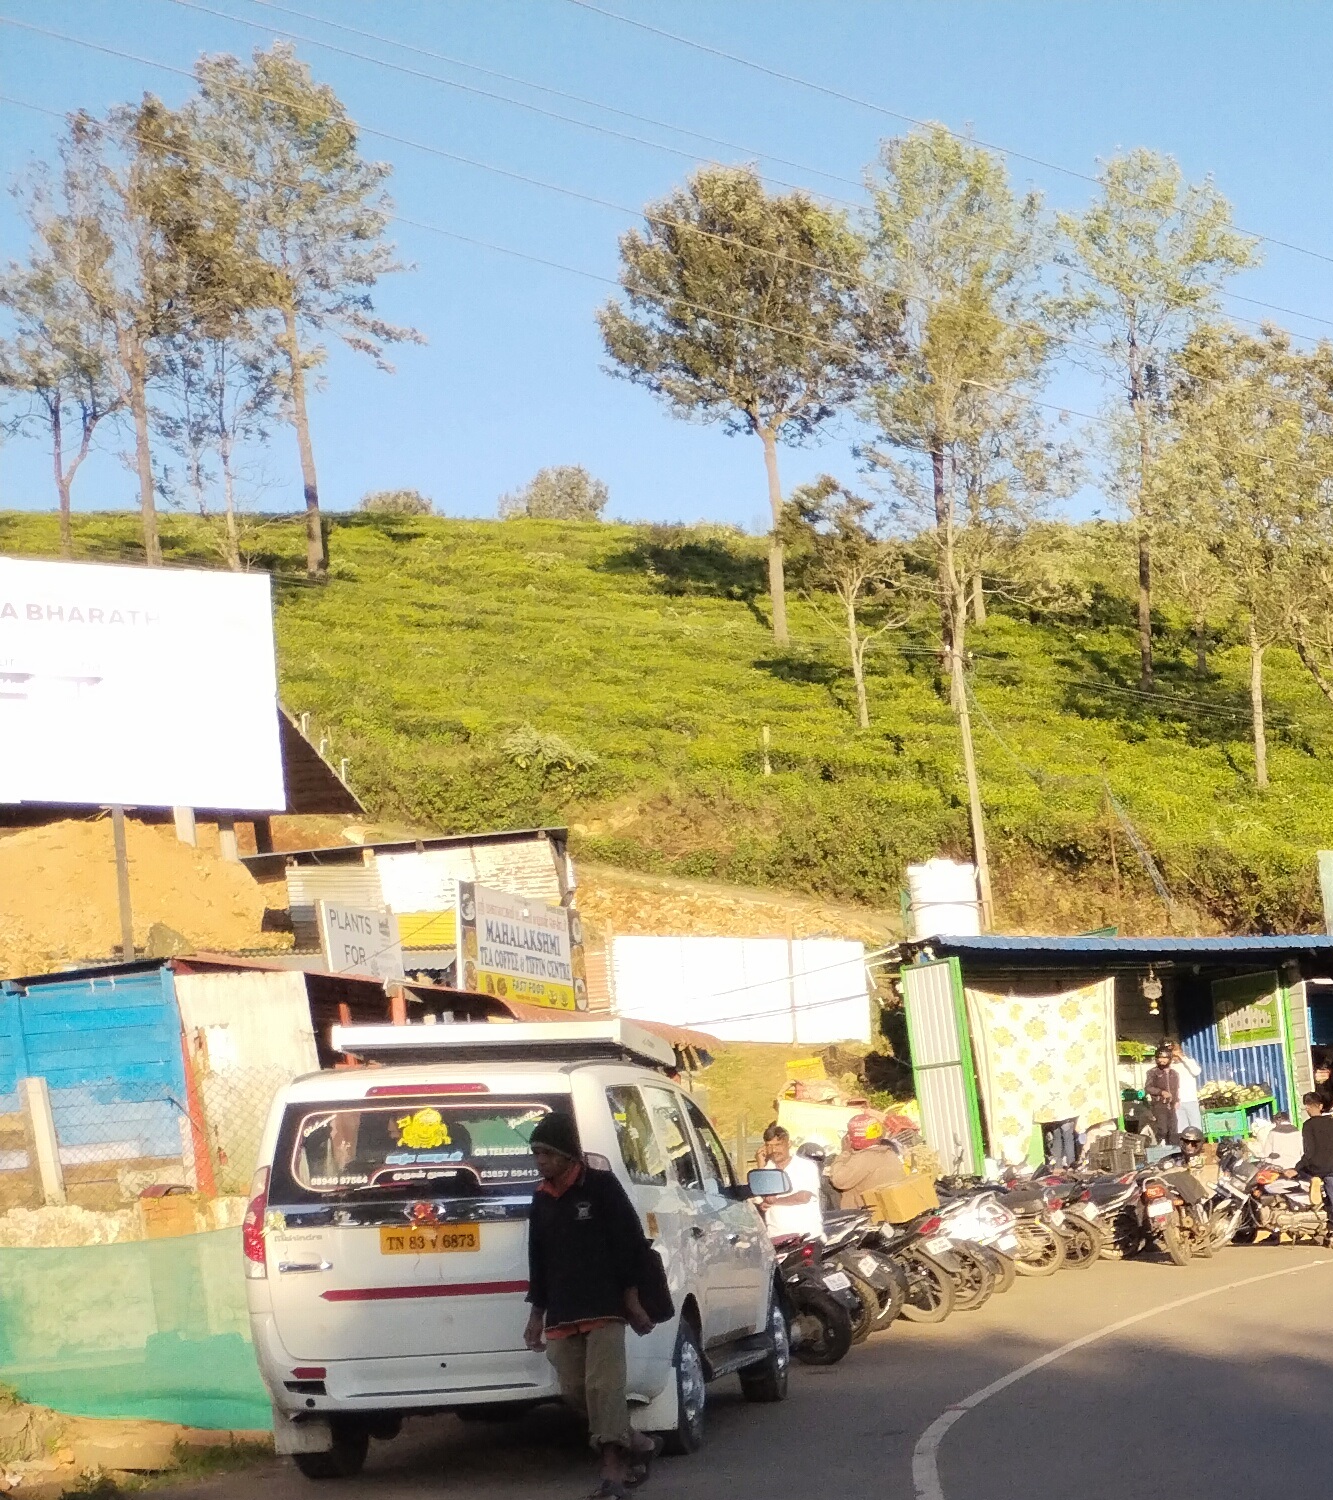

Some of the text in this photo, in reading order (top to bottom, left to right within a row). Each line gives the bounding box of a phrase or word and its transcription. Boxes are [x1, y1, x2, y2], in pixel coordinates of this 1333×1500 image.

[328, 908, 372, 936] PLANTS
[485, 918, 561, 956] MAHALAKSHMI
[344, 944, 366, 967] FOR
[480, 946, 493, 967] TEA
[494, 949, 520, 972] COFFEE
[525, 955, 546, 977] TIFFIN
[547, 960, 571, 981] CENTRE
[512, 978, 545, 996] FAST FOOD
[386, 1233, 475, 1251] TN 83 V 6873
